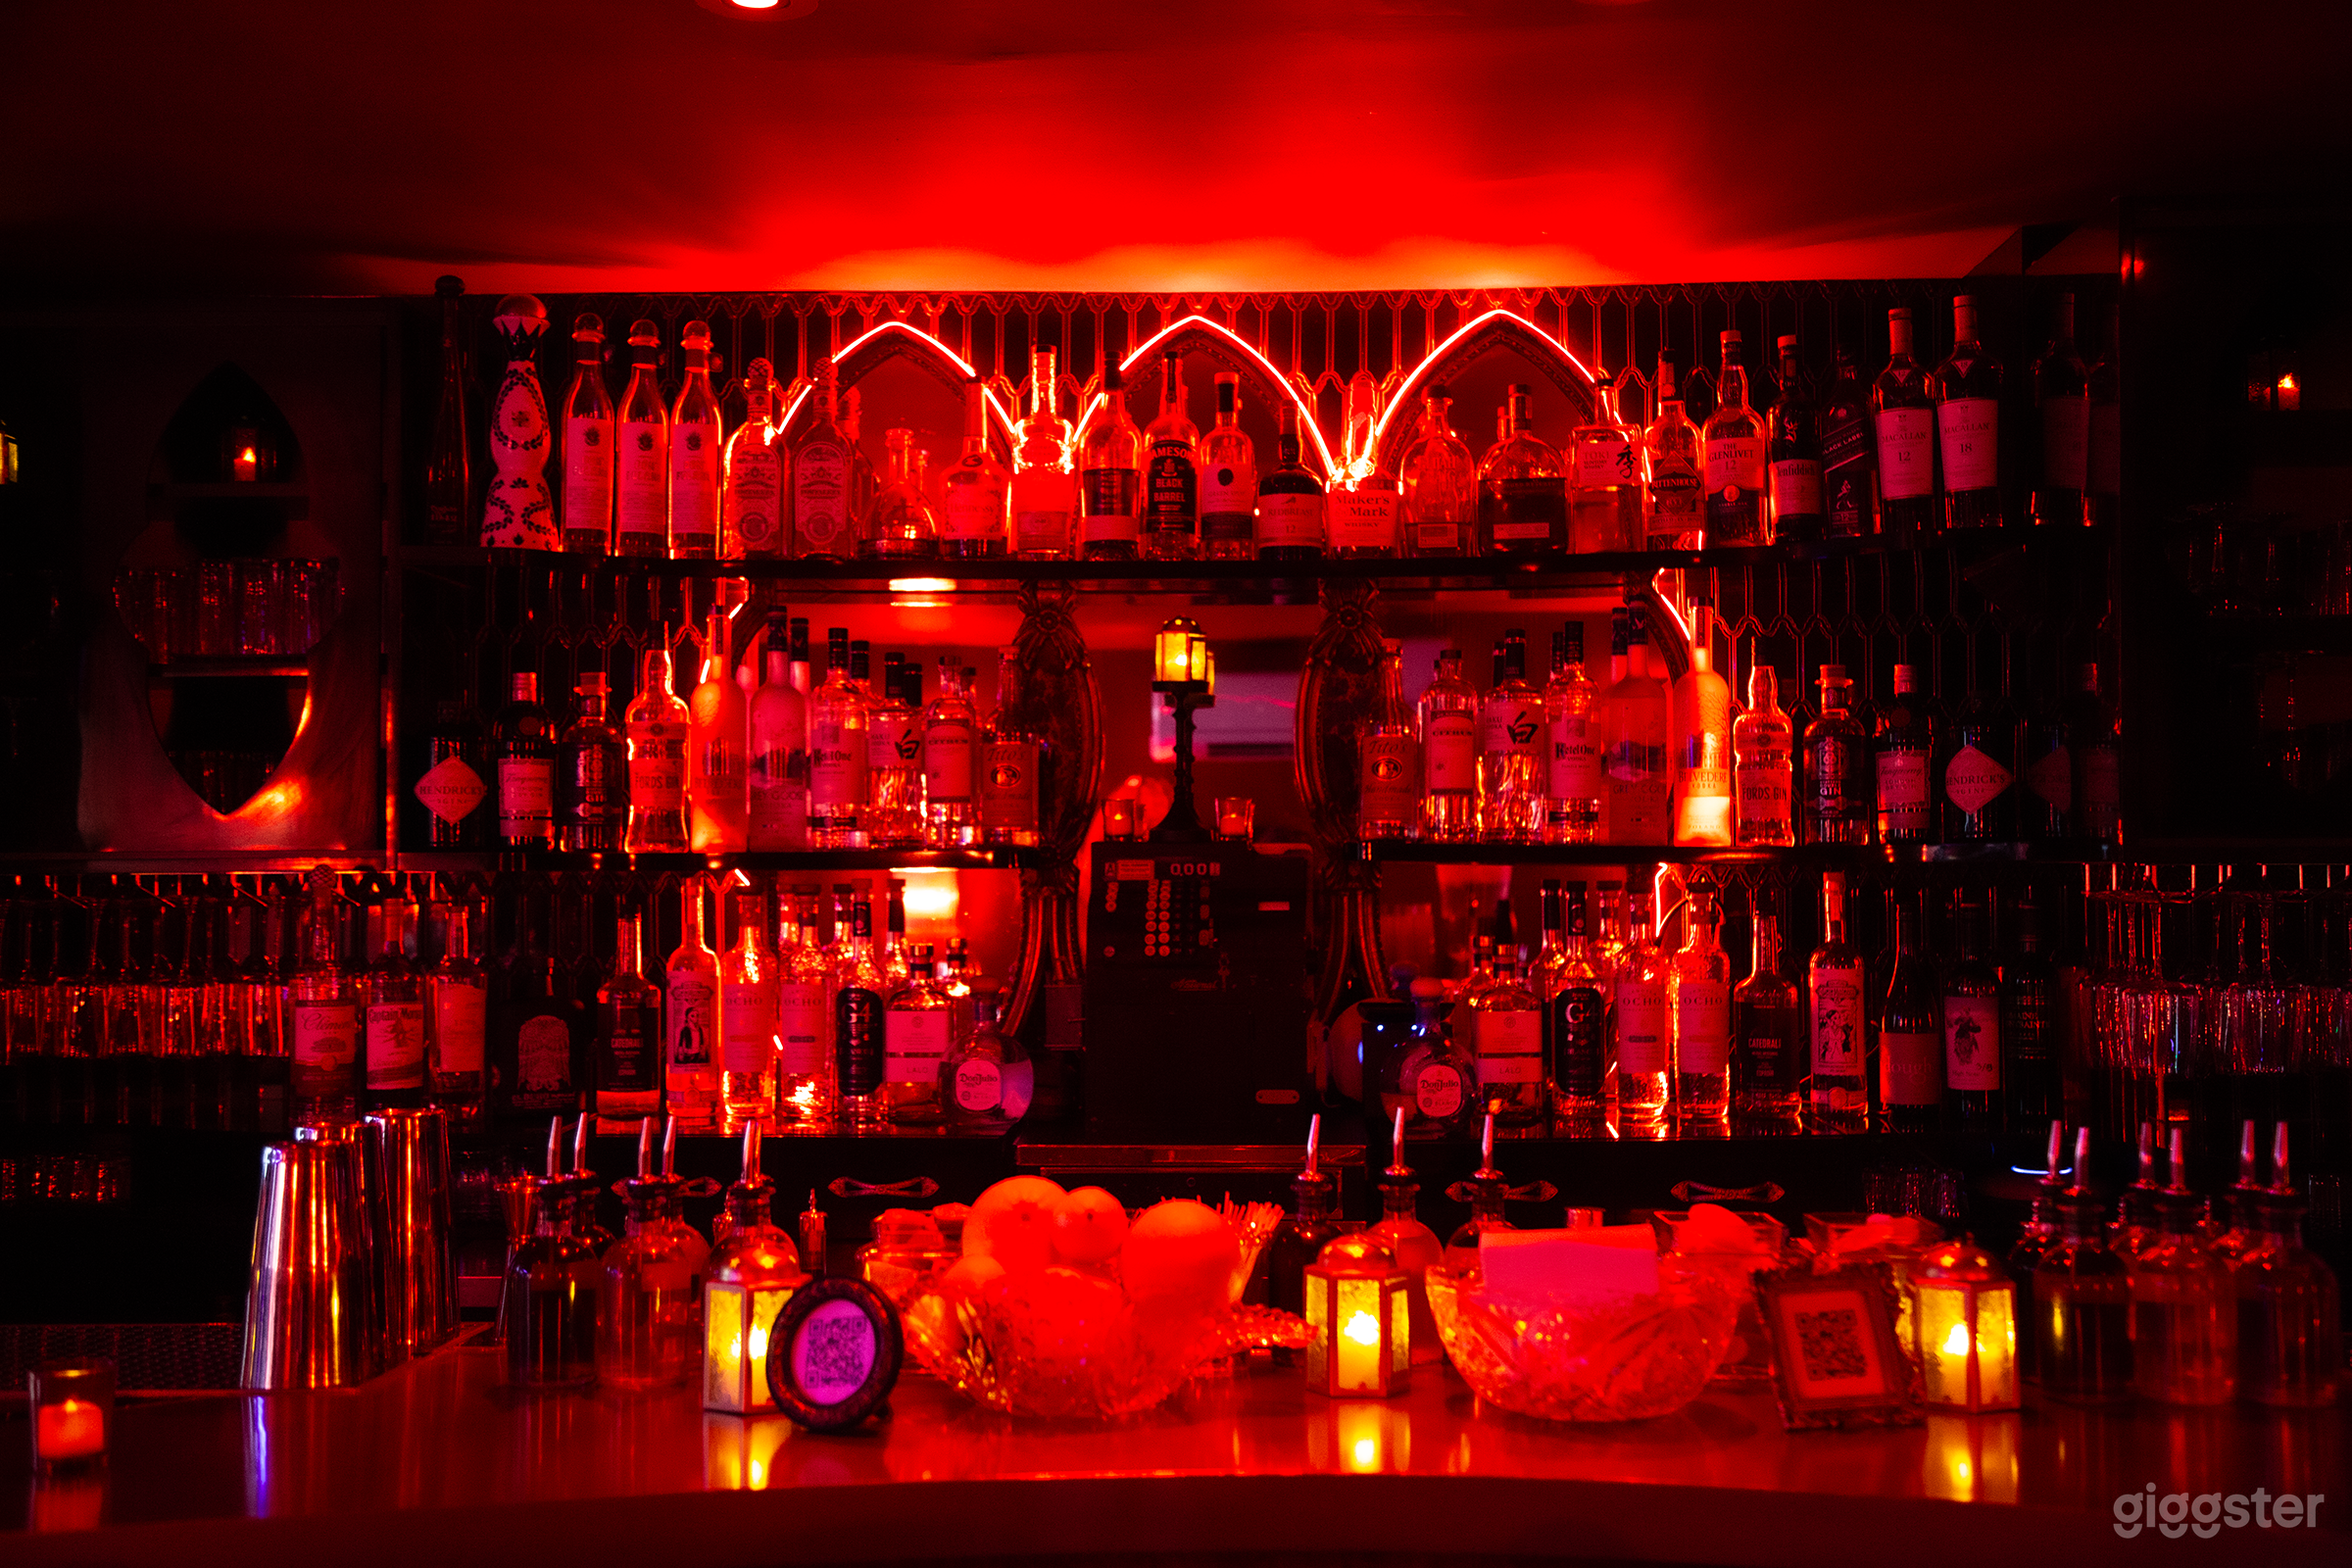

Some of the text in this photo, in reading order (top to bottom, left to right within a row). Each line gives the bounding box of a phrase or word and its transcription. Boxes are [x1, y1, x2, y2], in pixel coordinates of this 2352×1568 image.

[1960, 442, 1972, 453] 18
[1584, 451, 1609, 460] TOKI
[1708, 450, 1753, 463] GLENLIVET
[1898, 452, 1910, 462] 12
[1725, 460, 1737, 470] 12
[1155, 478, 1184, 488] BLACK
[1153, 492, 1186, 502] BARREL
[1336, 495, 1390, 505] Maker's
[950, 504, 994, 514] Hennessy
[1349, 507, 1389, 517] Mark
[1369, 741, 1408, 754] Tito's
[1580, 745, 1595, 756] One
[987, 748, 1026, 761] Tito's
[1742, 787, 1787, 801] FORDS GIN
[1820, 787, 1841, 796] GIN
[725, 997, 763, 1005] OCHO
[785, 998, 821, 1006] OCHO
[1623, 997, 1662, 1006] OCHO
[1683, 997, 1723, 1006] OCHO
[1564, 1003, 1599, 1024] G4
